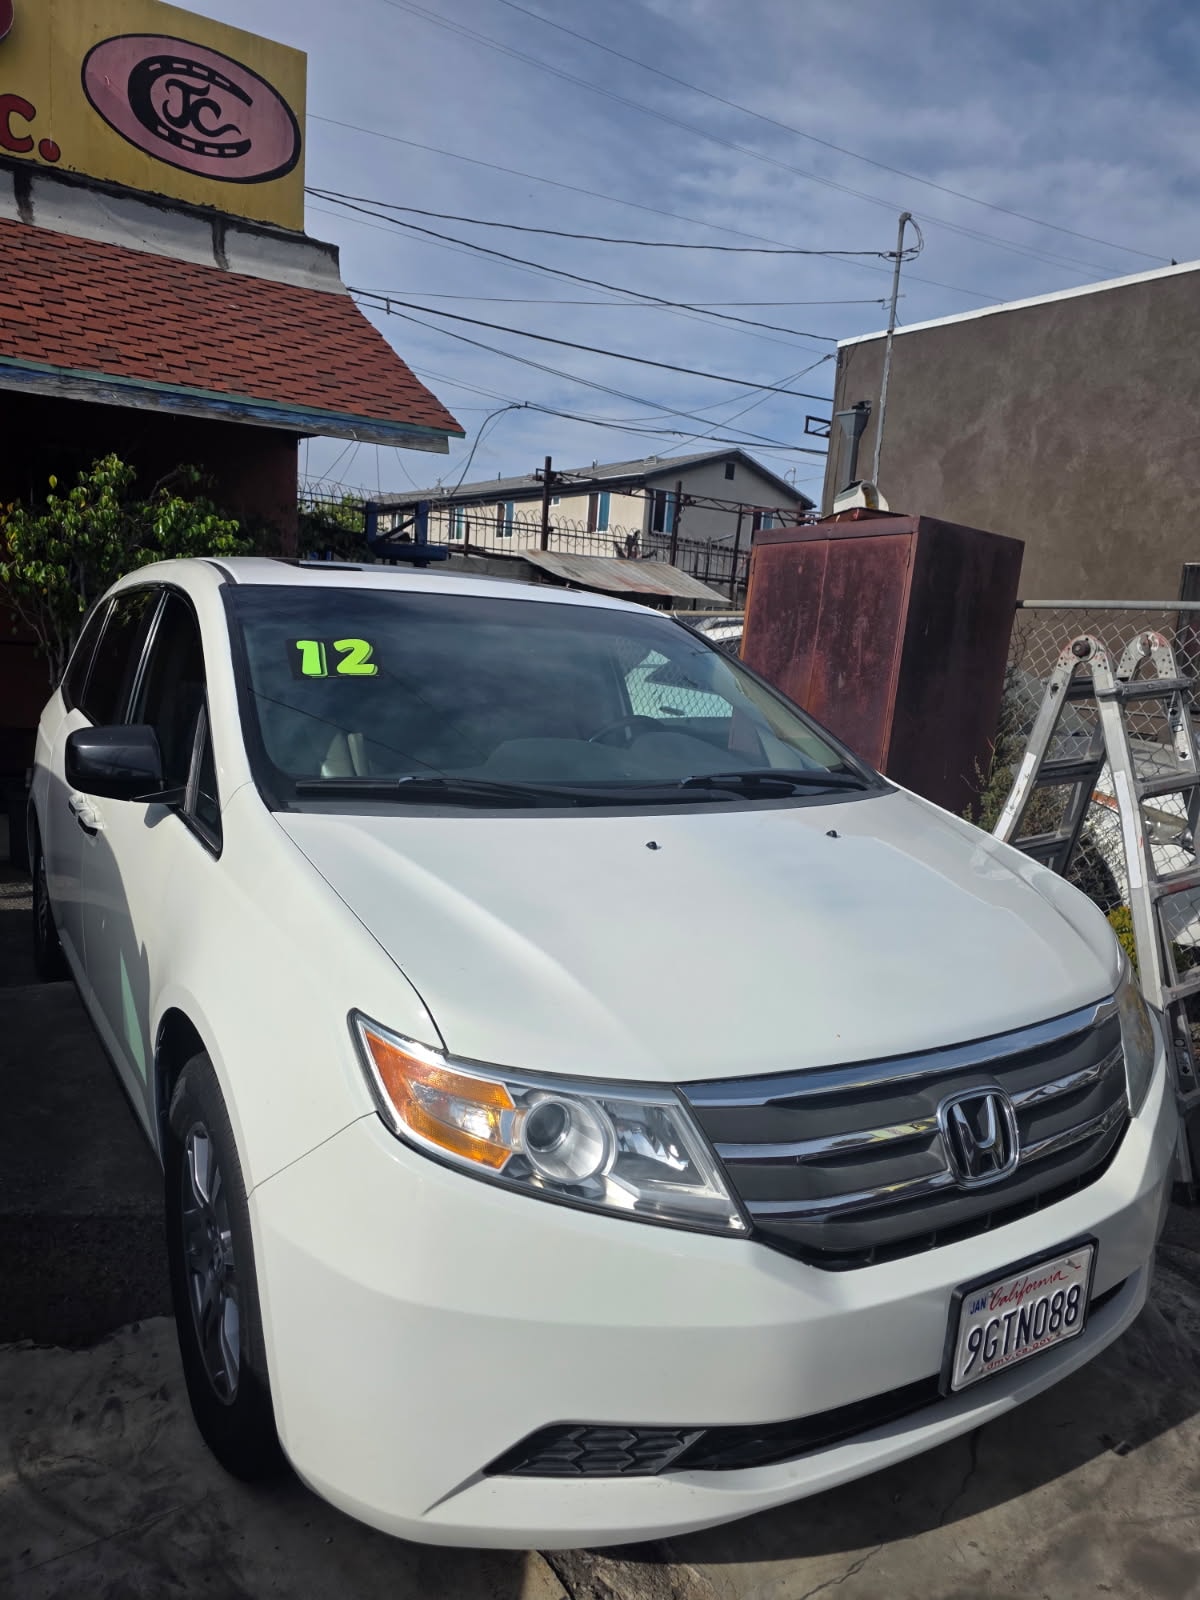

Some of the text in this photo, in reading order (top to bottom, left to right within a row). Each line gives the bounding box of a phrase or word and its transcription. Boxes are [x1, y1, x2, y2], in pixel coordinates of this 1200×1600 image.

[296, 638, 378, 677] 12
[970, 1270, 1069, 1315] JAN California
[963, 1284, 1081, 1376] 9GTN088
